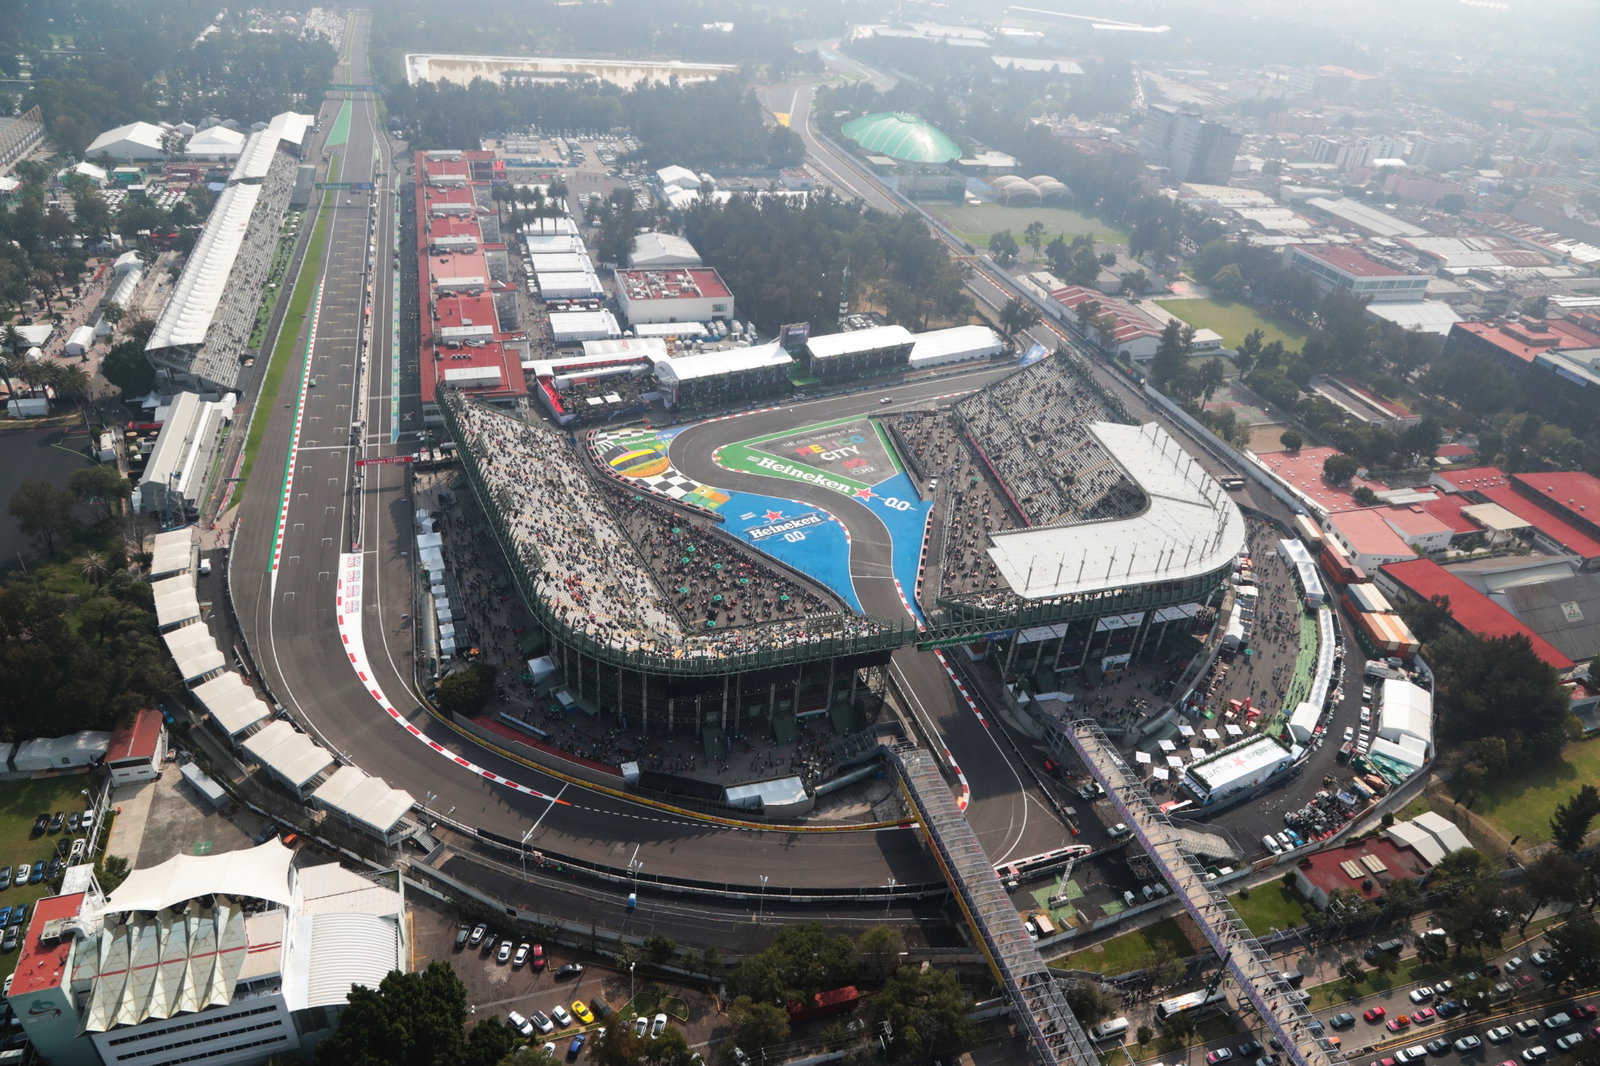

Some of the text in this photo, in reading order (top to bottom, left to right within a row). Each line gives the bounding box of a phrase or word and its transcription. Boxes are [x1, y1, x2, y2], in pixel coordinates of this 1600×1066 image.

[795, 435, 865, 457] MEXICO
[820, 445, 860, 461] CITY
[756, 456, 850, 494] Heineken
[749, 515, 821, 539] Heineken
